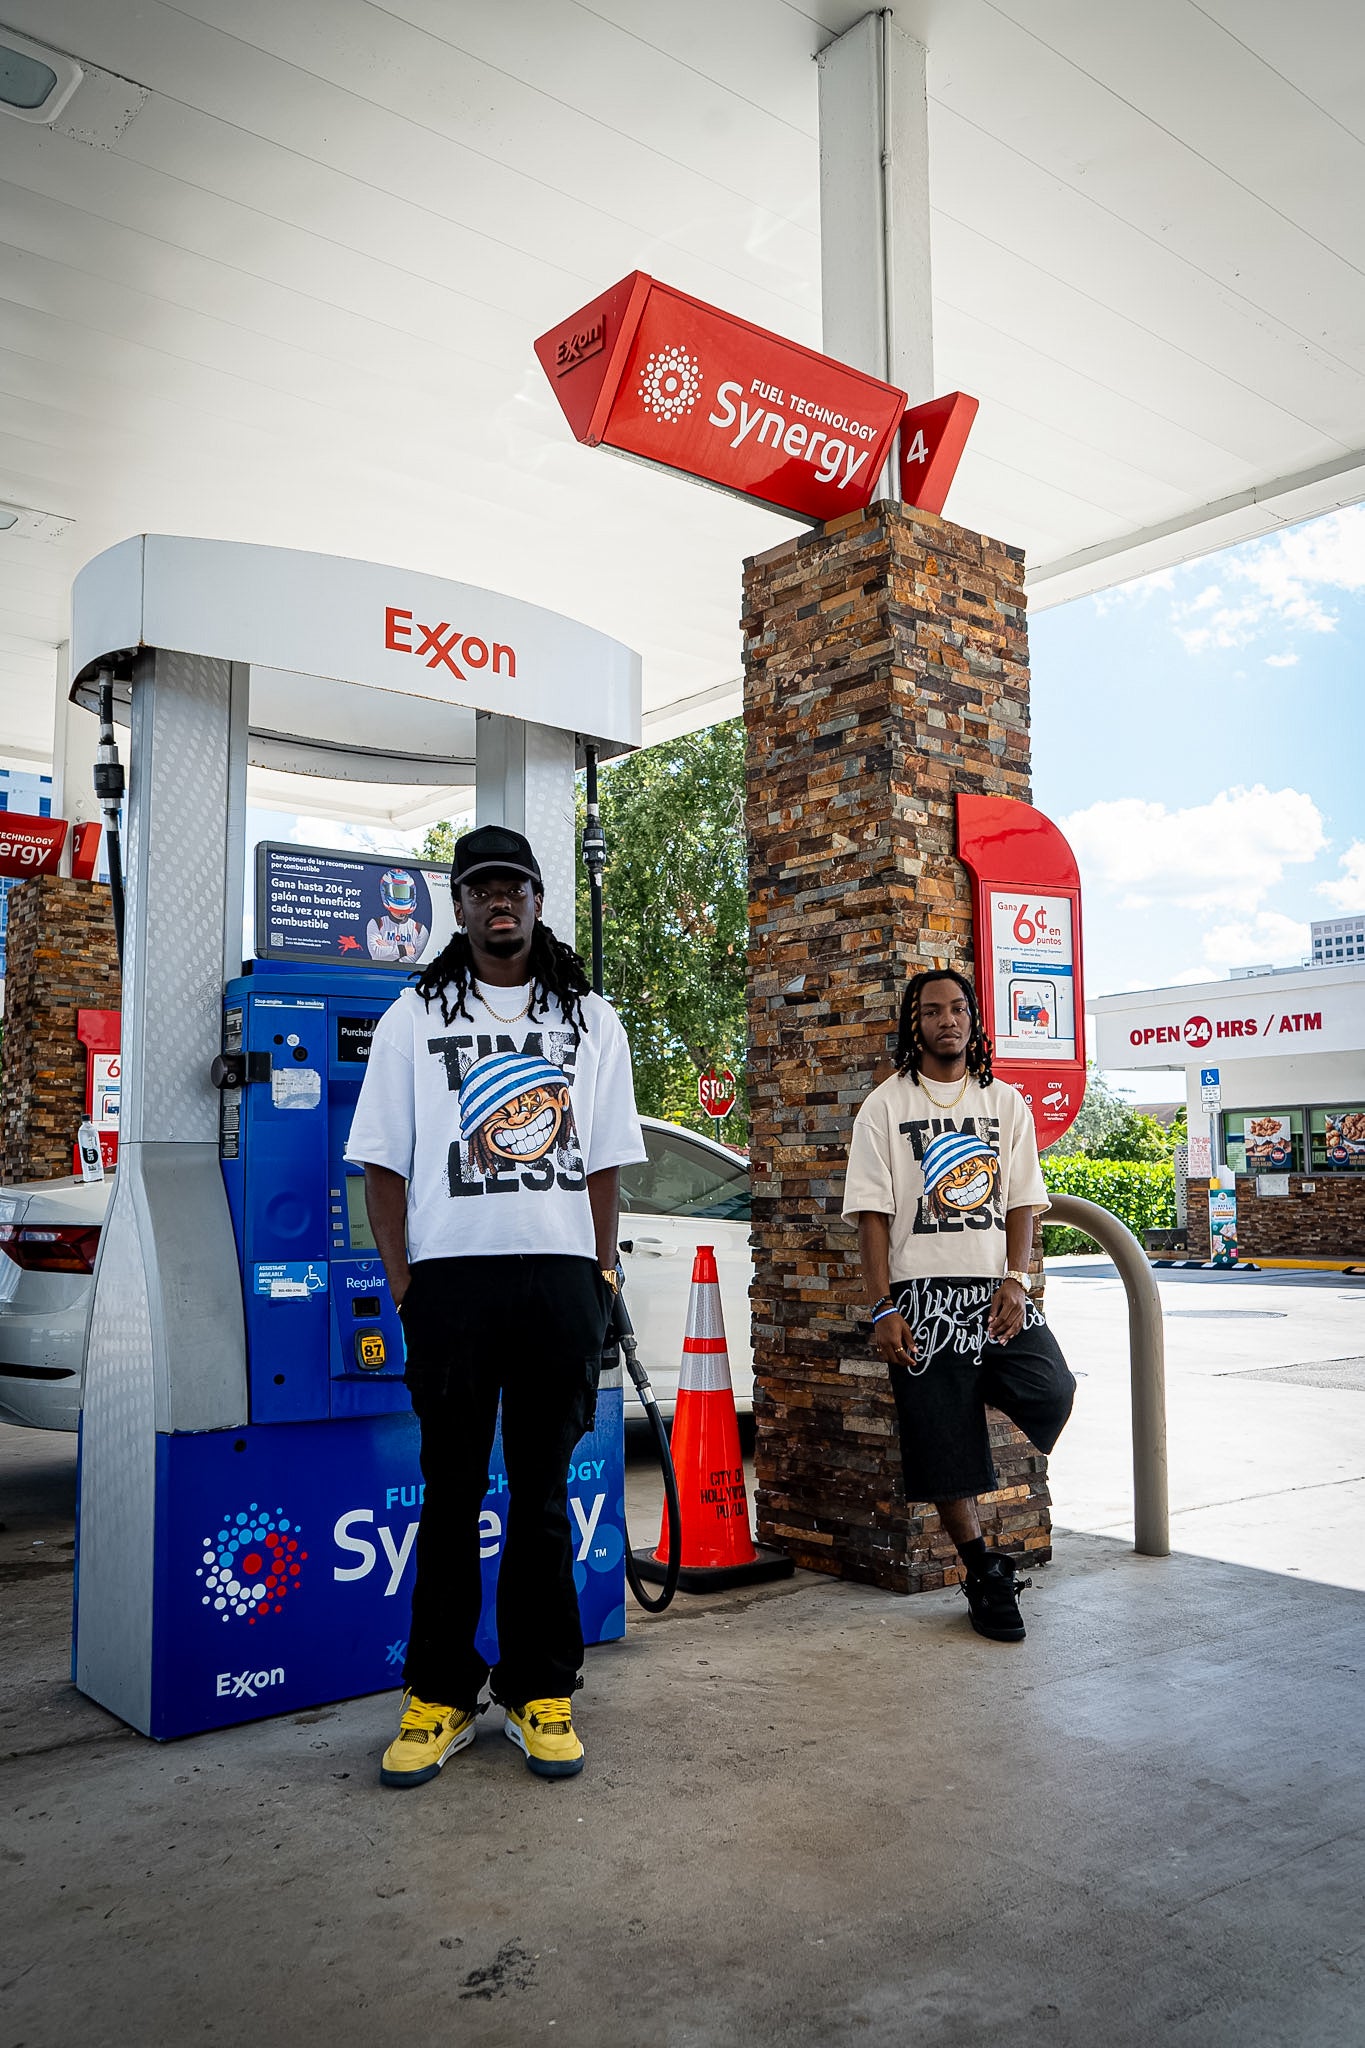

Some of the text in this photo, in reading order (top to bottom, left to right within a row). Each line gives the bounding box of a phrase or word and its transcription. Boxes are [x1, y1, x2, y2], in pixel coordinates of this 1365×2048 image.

[556, 323, 602, 365] Exxon
[750, 378, 878, 442] FUEL TECHNOLOGY
[708, 381, 869, 491] Synergy
[906, 429, 929, 464] 4
[385, 606, 516, 681] Exxon
[0, 832, 54, 845] ECHNOLOGY
[74, 834, 80, 853] 2
[0, 842, 52, 867] ergy
[271, 853, 307, 864] Campeones
[316, 858, 325, 866] las
[326, 860, 364, 871] recompensas
[283, 863, 320, 873] combustible
[271, 878, 361, 897] Gana hasta 20¢ por
[271, 891, 361, 909] galón en beneficios
[271, 904, 360, 920] cada vez que eches
[271, 917, 329, 929] combustible
[997, 901, 1061, 945] Gana 6¢ en
[387, 931, 412, 942] Mobil
[1036, 937, 1062, 946] puntos
[1129, 1012, 1322, 1046] OPEN 24 HRS / ATM
[701, 1079, 733, 1101] STOP
[1047, 1082, 1063, 1090] CCTV
[346, 1276, 386, 1290] Regular
[364, 1344, 382, 1357] 87
[710, 1469, 732, 1487] CITY
[386, 1483, 427, 1510] FU
[333, 1493, 606, 1597] Syey
[216, 1667, 285, 1698] Exxon
